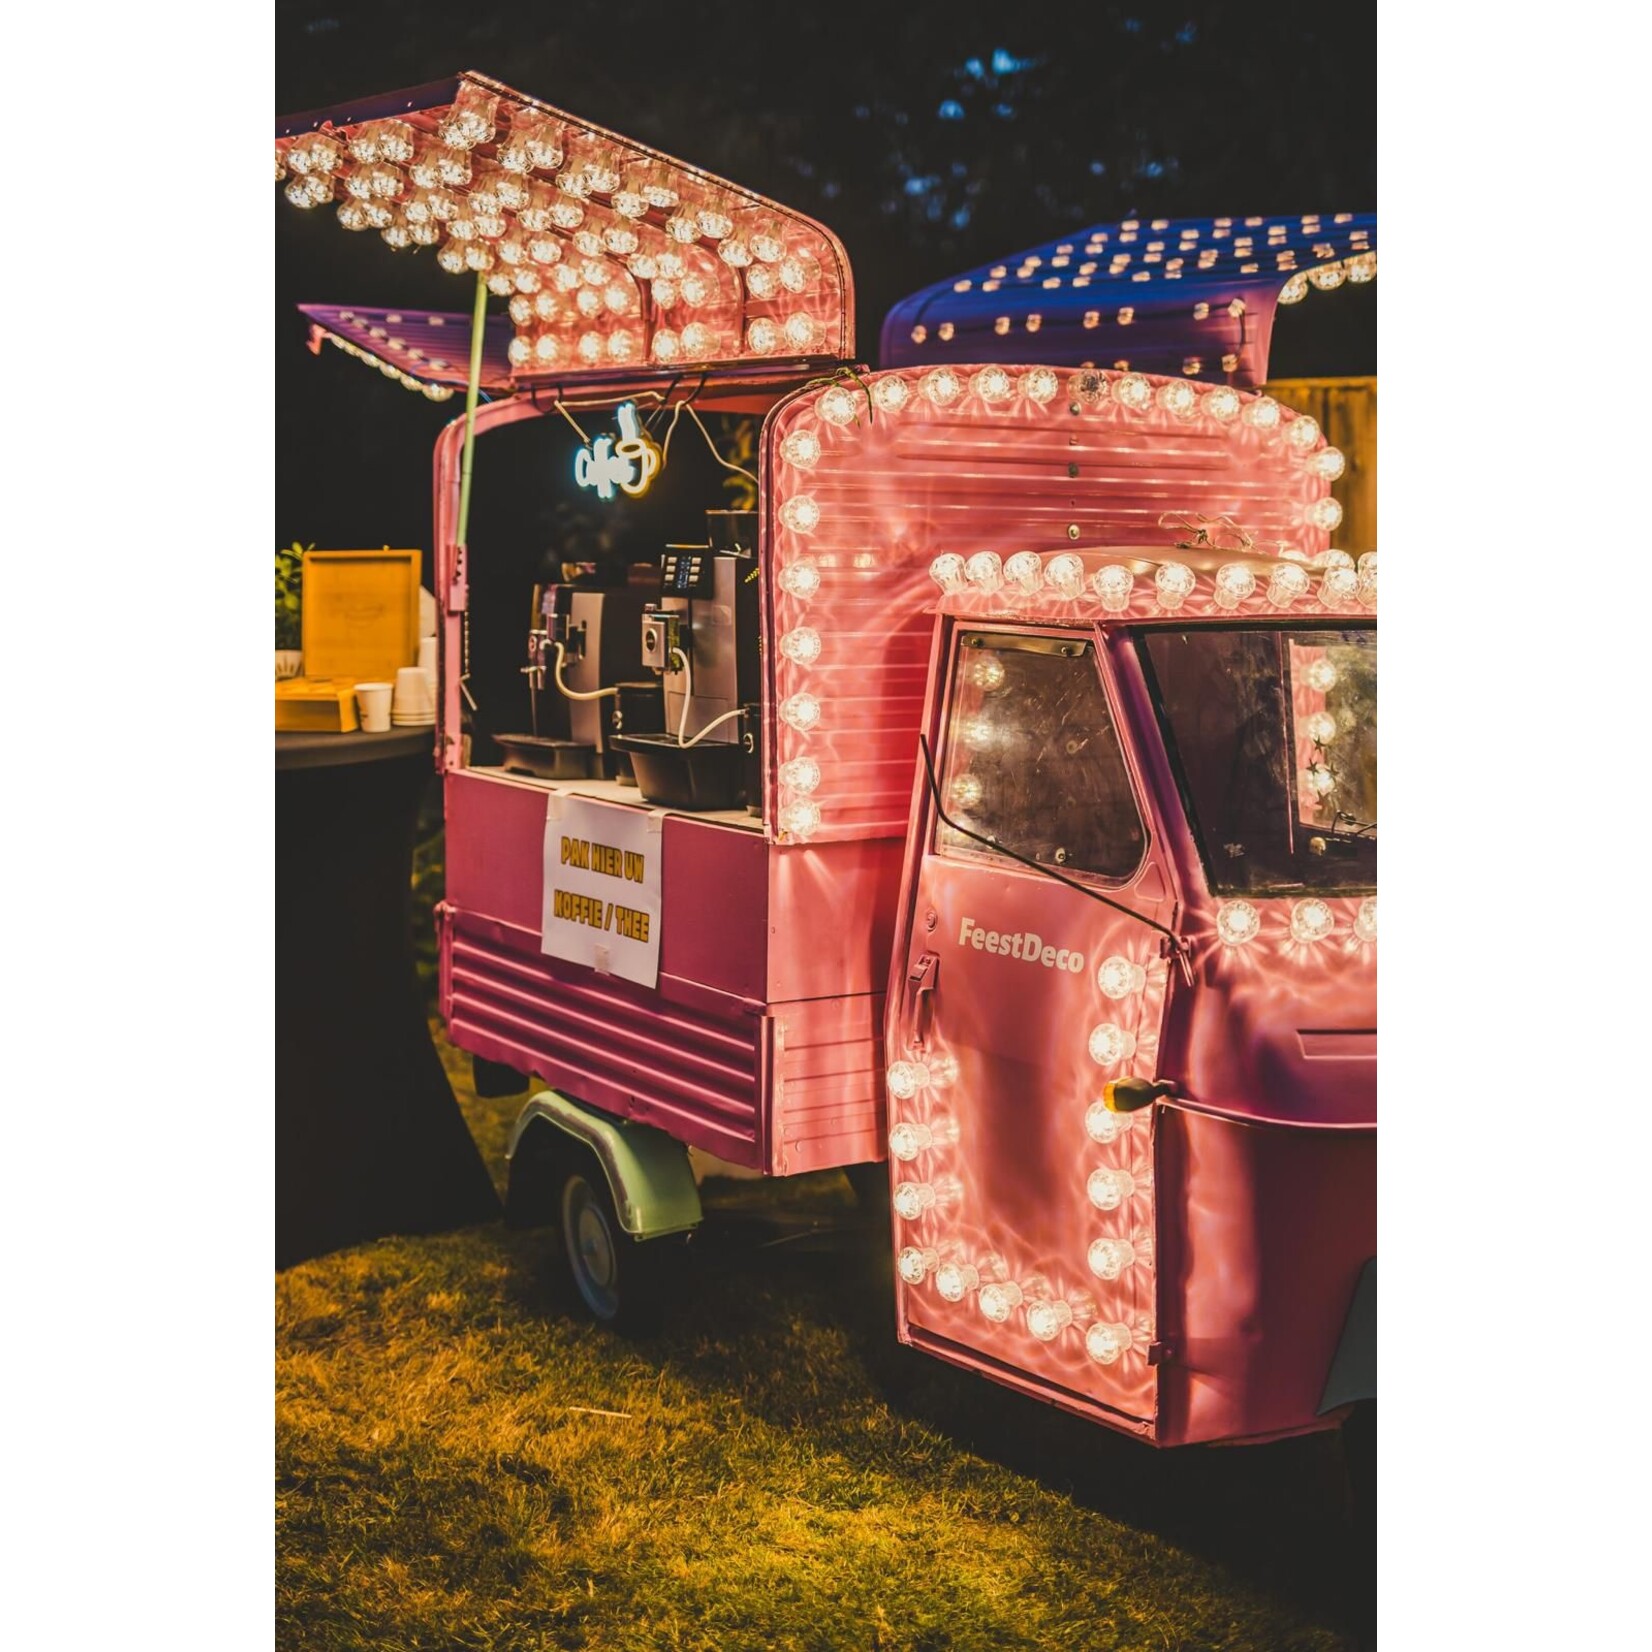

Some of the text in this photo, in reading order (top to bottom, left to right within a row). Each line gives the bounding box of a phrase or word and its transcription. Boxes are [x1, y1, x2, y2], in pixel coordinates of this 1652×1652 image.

[561, 836, 645, 884] PAK HIER UW
[554, 889, 650, 943] KOFFIE / THEE
[958, 916, 1085, 974] FeestDeco
